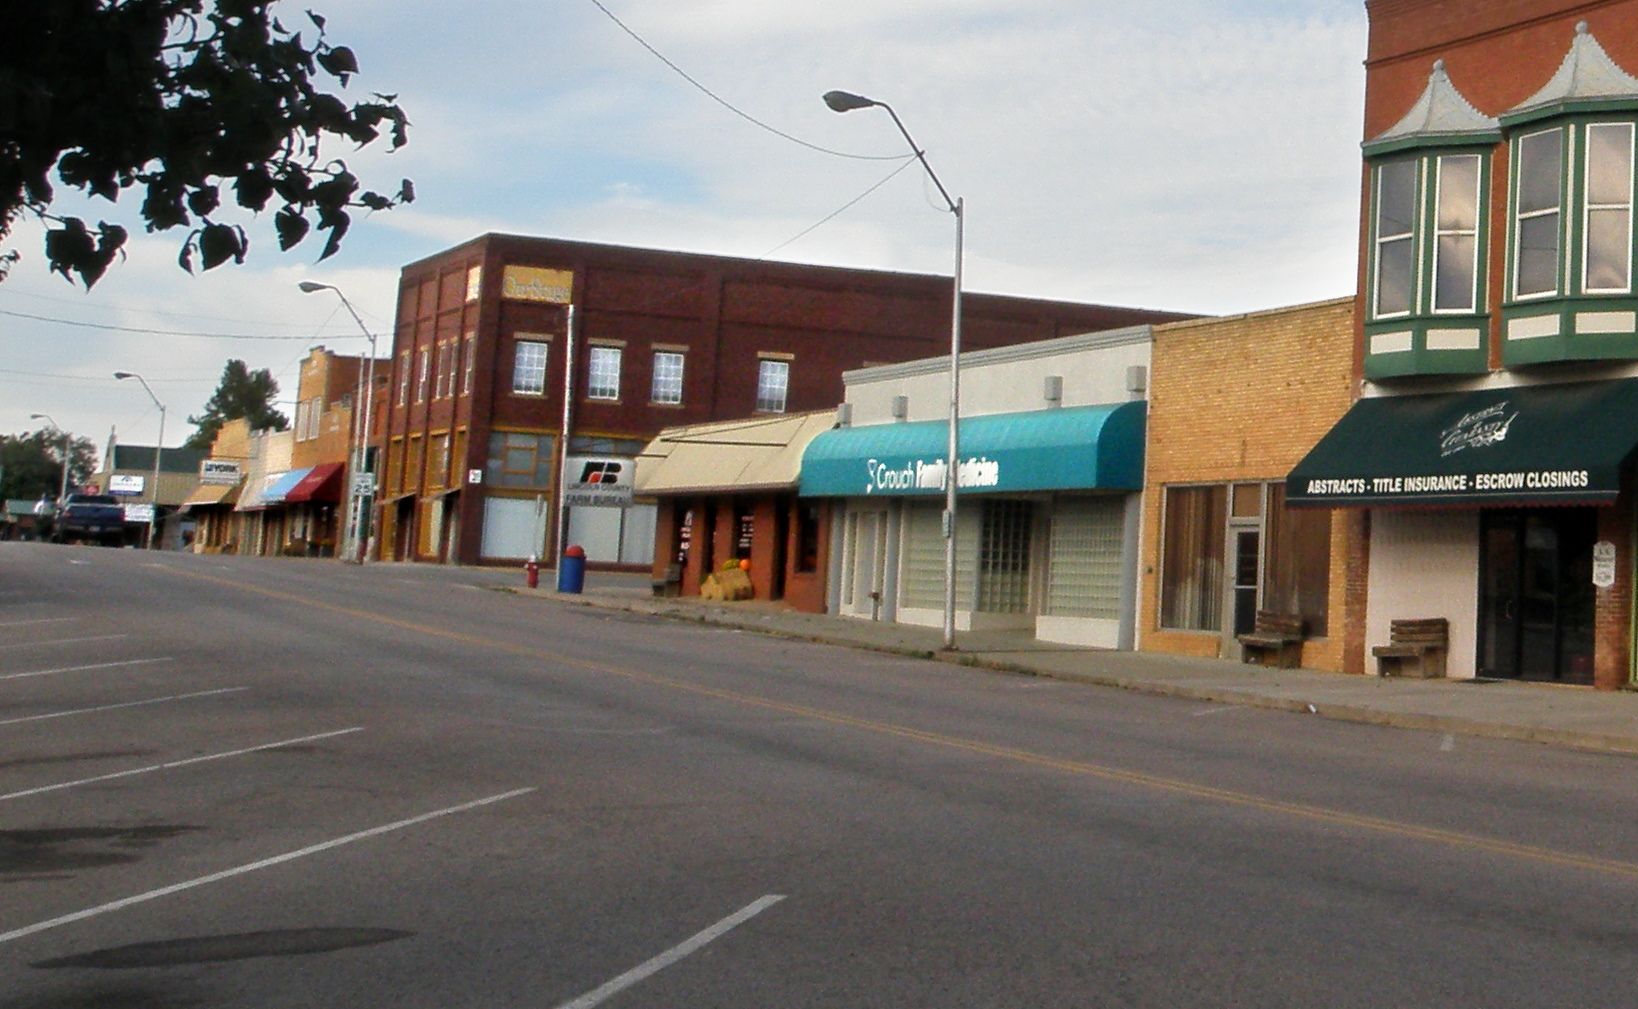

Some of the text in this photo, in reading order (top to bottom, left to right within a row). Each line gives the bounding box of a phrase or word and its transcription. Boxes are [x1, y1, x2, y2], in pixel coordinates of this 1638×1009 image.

[956, 456, 999, 488] edicine
[1307, 470, 1589, 494] ABSTRACTS TITLE INSURANCE ESCROW CLOSINGS
[566, 494, 592, 506] FARM
